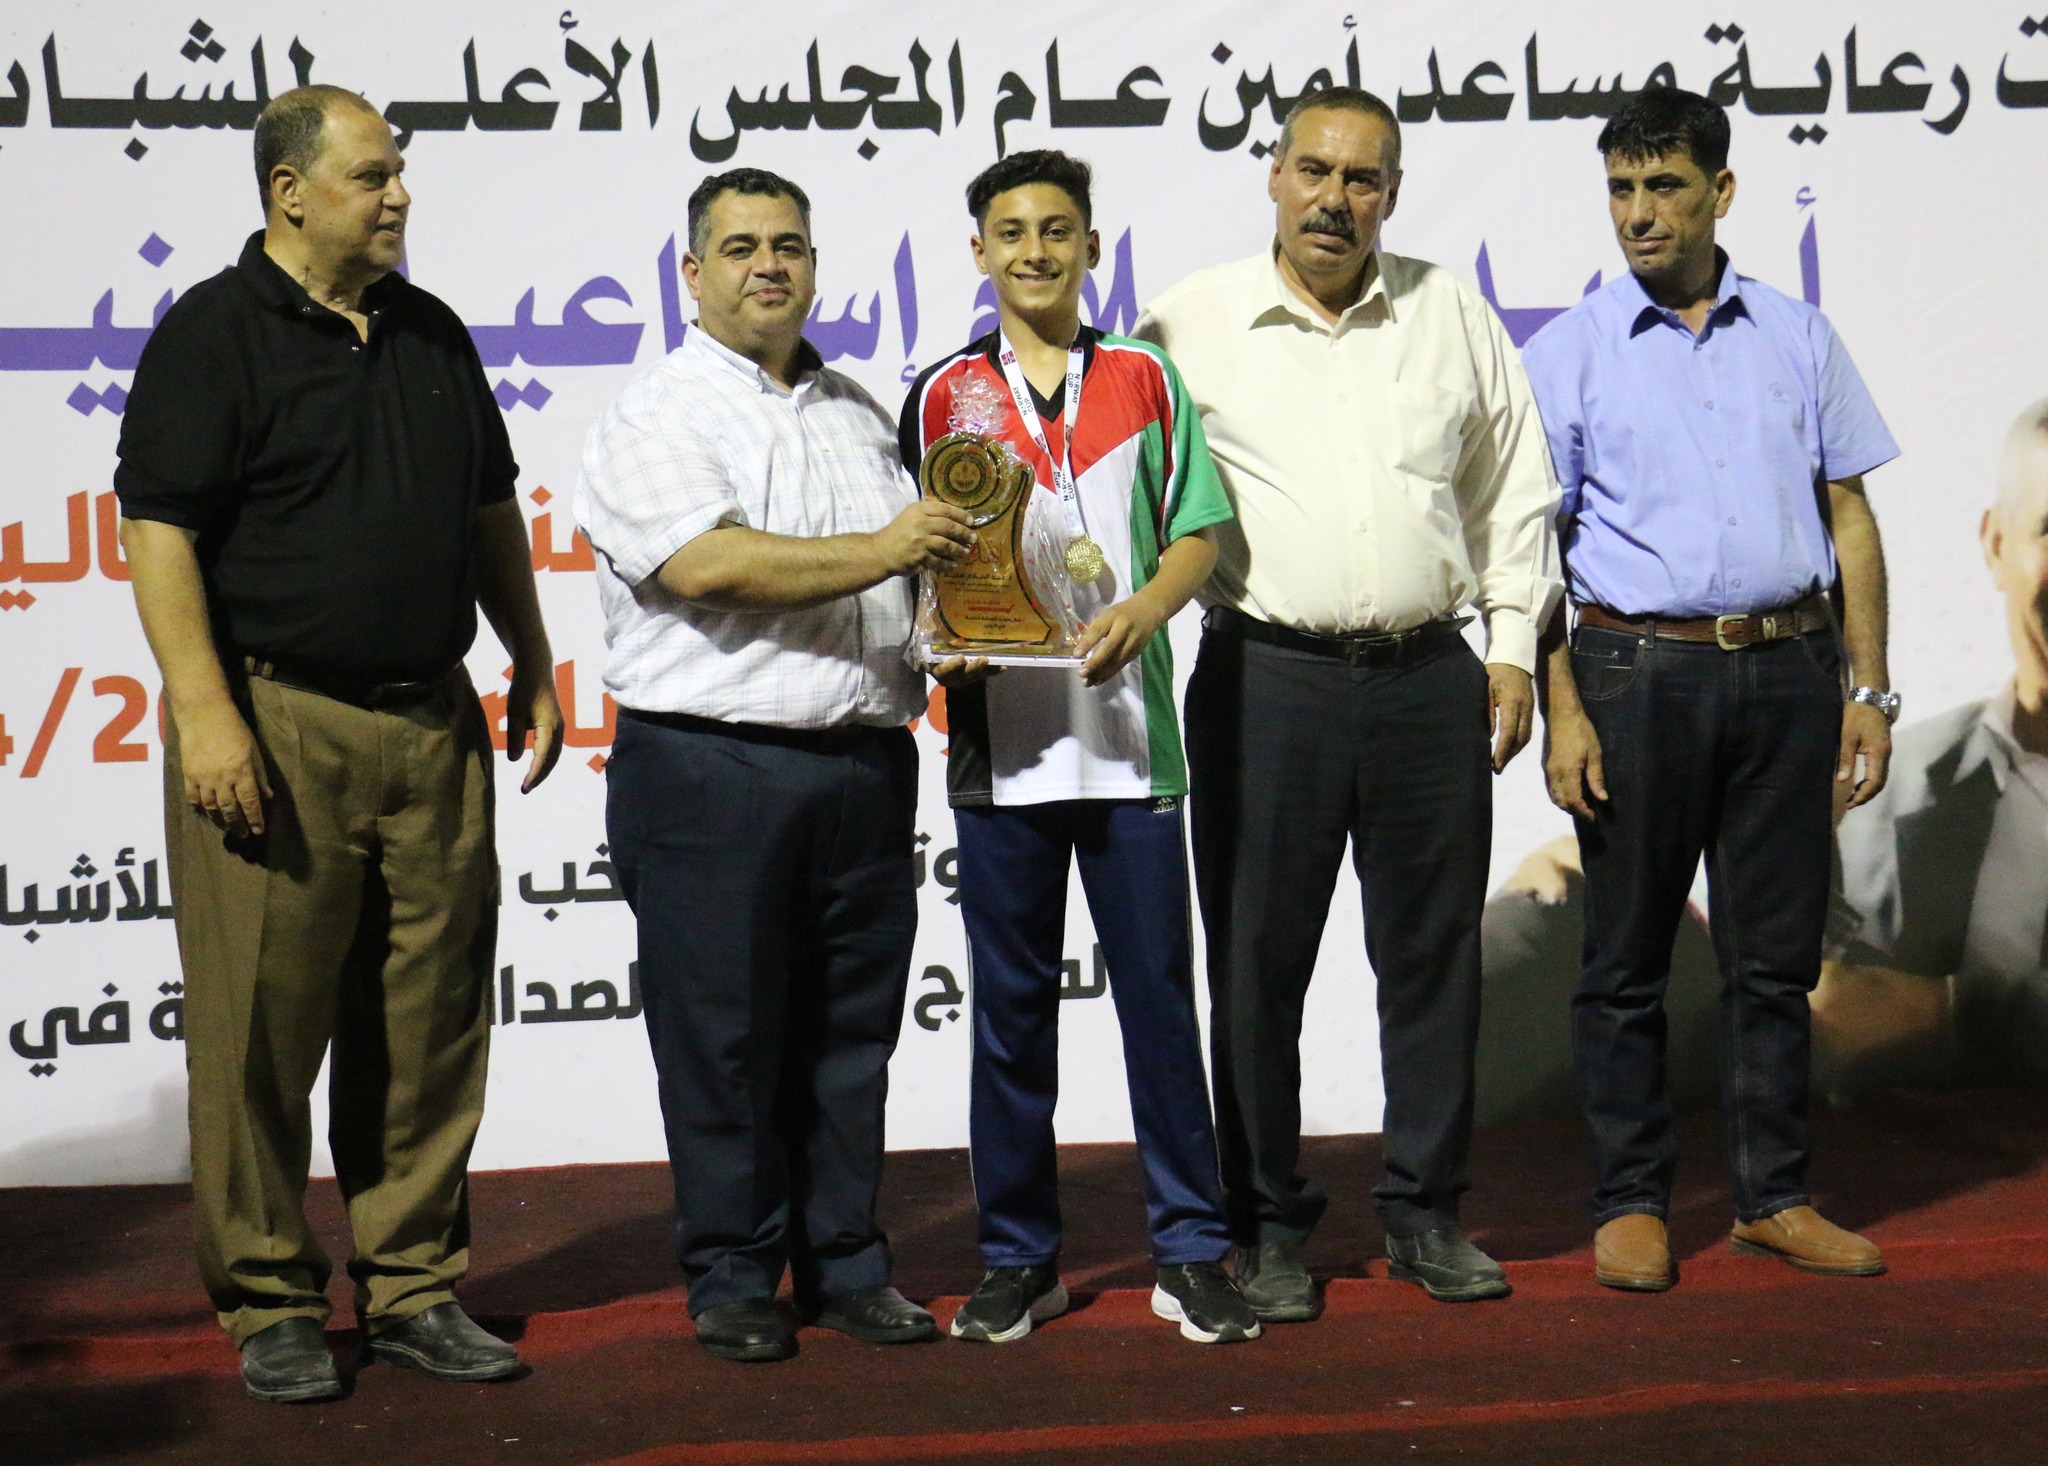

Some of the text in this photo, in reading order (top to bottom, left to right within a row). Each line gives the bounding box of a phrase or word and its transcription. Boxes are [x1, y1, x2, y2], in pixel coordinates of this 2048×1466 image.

[689, 36, 962, 163] المجلس
[993, 36, 1172, 158] عام
[1704, 22, 1970, 145] رعاية
[1024, 397, 1034, 413] CUP
[9, 982, 130, 1078] في
